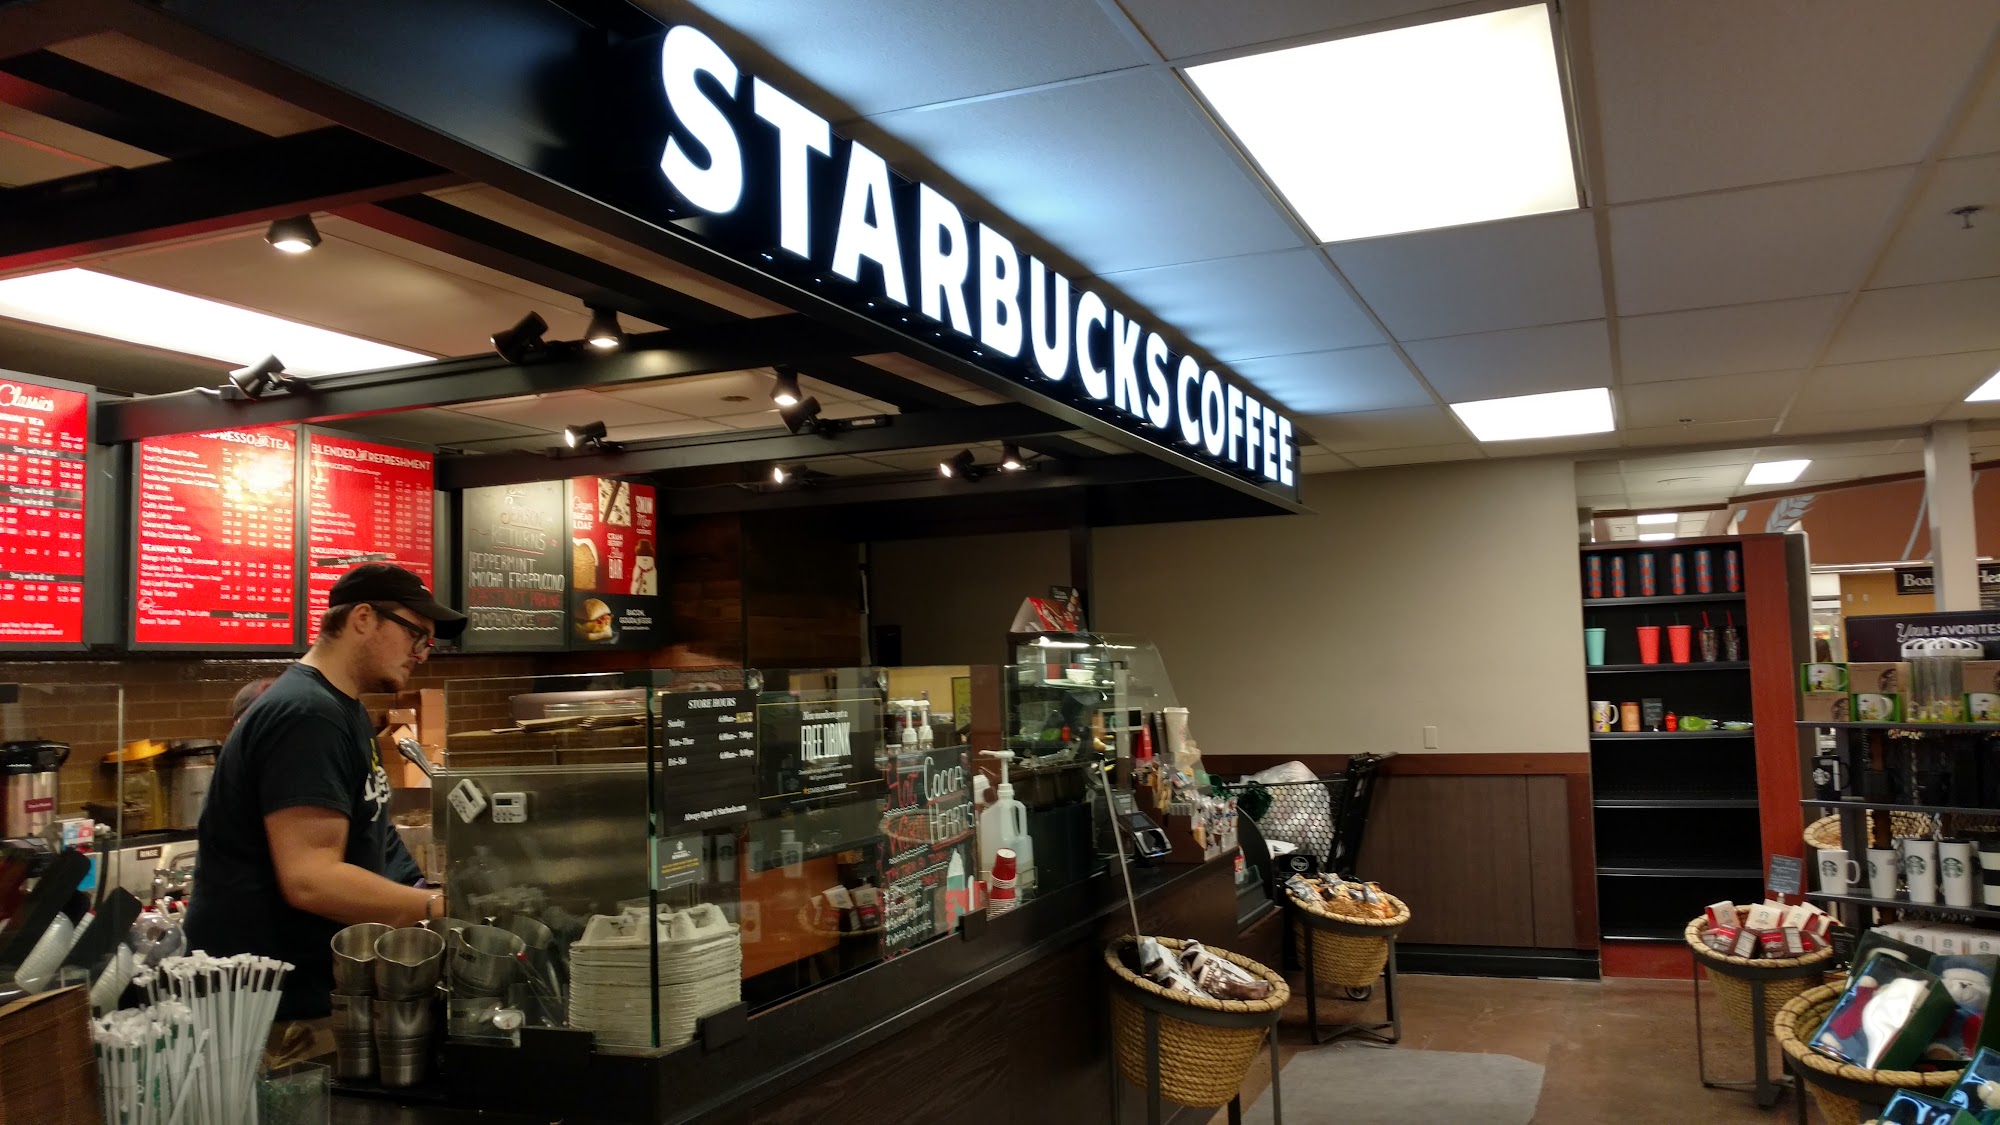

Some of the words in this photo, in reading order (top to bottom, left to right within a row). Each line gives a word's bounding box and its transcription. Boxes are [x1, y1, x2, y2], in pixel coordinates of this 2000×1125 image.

[660, 25, 1170, 431] STARBUCKS
[1177, 355, 1294, 488] COFFEE
[269, 438, 291, 451] TEA
[311, 443, 356, 460] BLENDED
[367, 452, 431, 470] REFRESHMENT
[573, 521, 594, 530] LOAF
[469, 552, 537, 574] PEPPERMINT
[469, 571, 504, 589] MOCHA
[1903, 573, 1935, 587] Boa
[1896, 623, 1931, 643] Your
[688, 699, 712, 709] STORE
[713, 697, 737, 708] HOURS
[801, 724, 823, 761] FREE
[823, 721, 852, 759] DRINK
